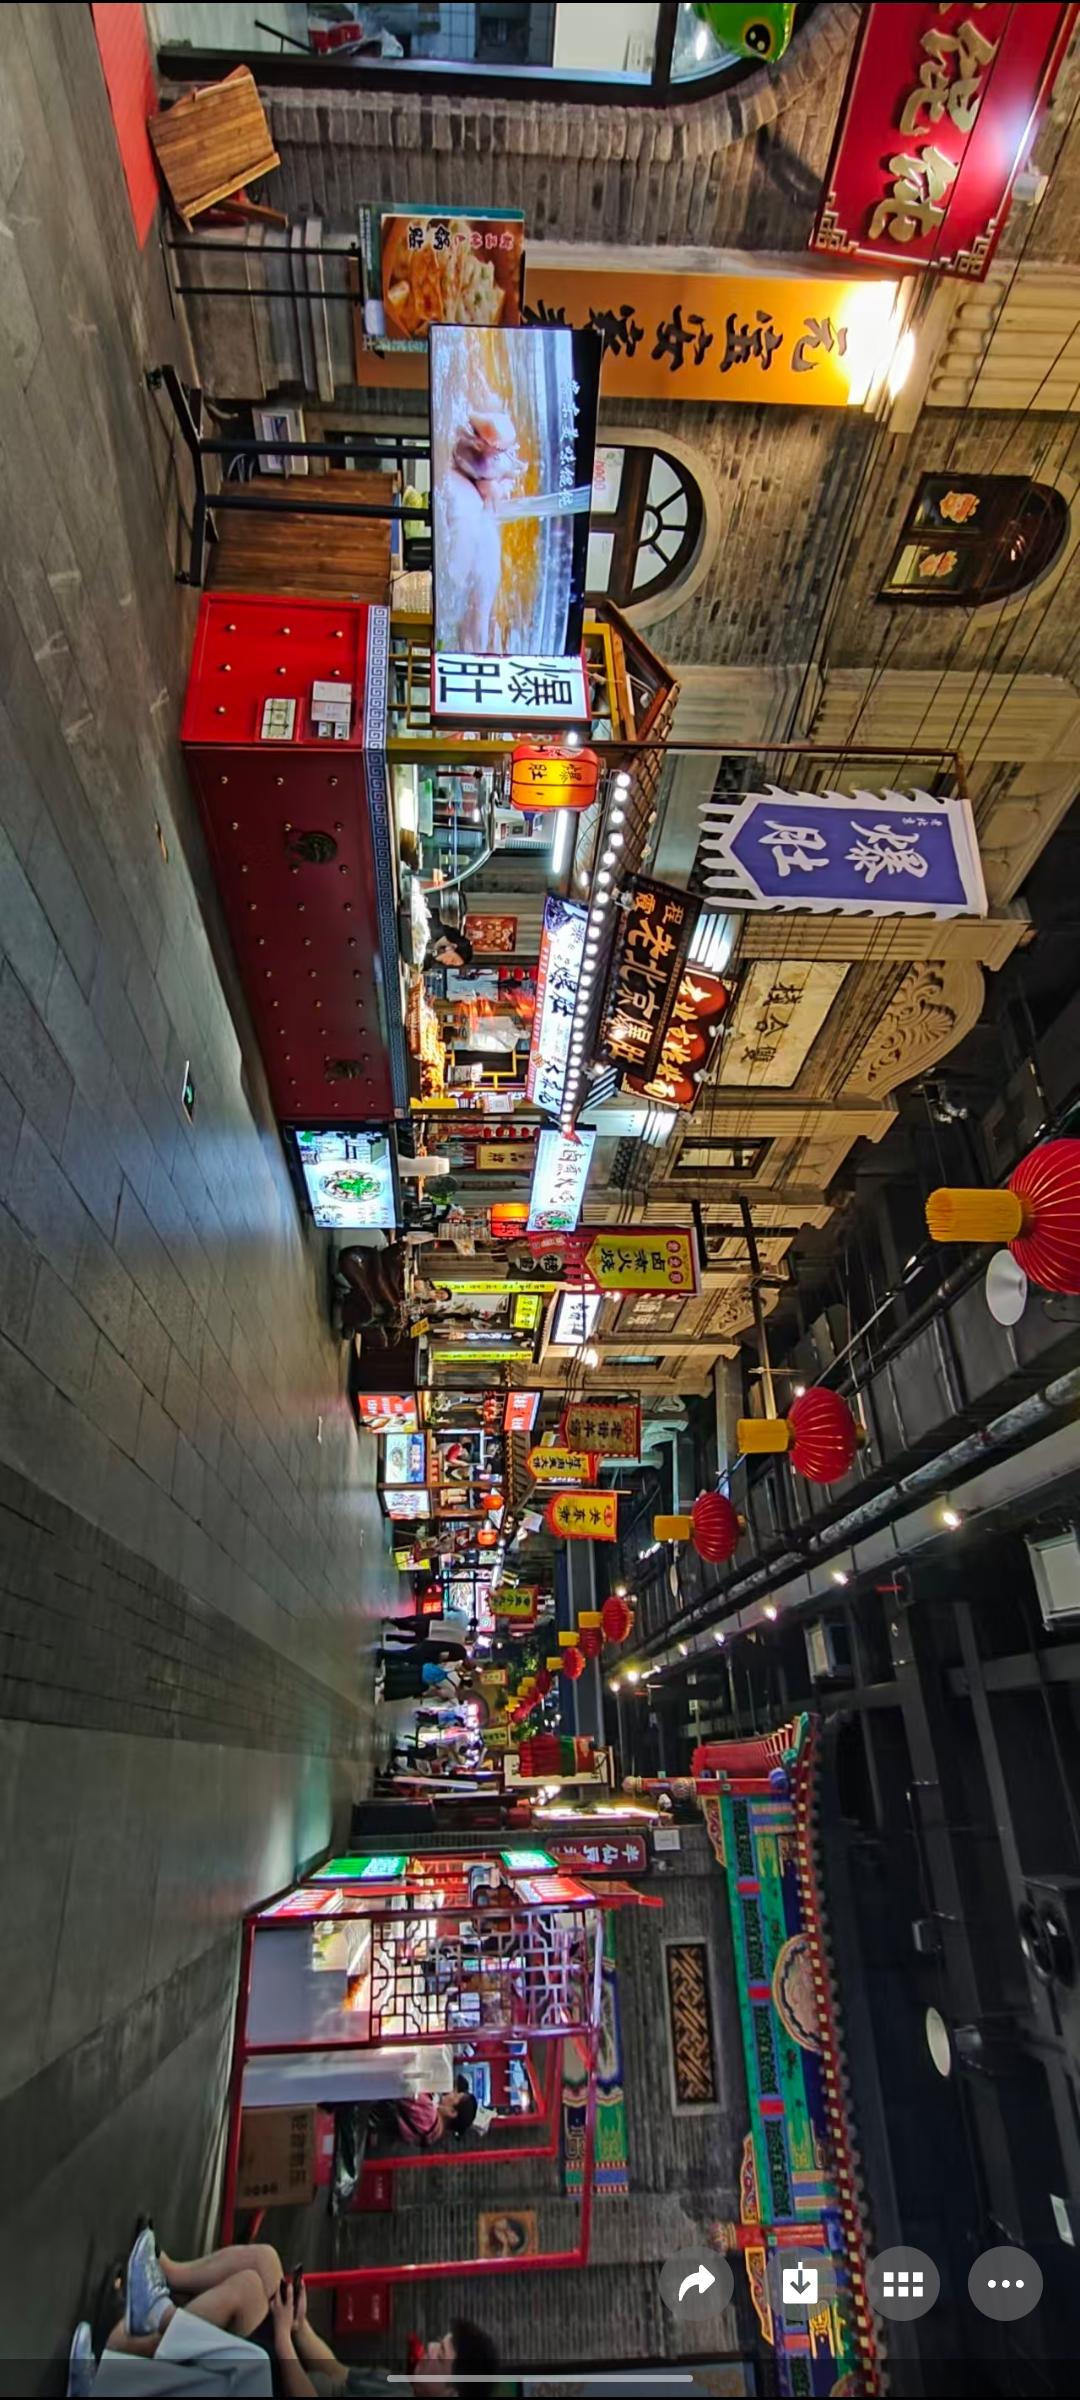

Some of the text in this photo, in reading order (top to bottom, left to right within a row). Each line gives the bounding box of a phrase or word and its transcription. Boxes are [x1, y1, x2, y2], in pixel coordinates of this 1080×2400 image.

[868, 4, 1000, 244] 馄饨
[408, 225, 451, 251] 锅贴
[436, 661, 573, 707] 爆肚
[527, 763, 583, 784] 爆肚
[901, 815, 943, 828] 老北京
[757, 821, 929, 885] 爆肚
[548, 966, 579, 1018] 爆肚
[605, 917, 675, 1066] 老北京爆肚
[600, 1247, 666, 1274] 卤煮火烧
[558, 1505, 601, 1525] 关东煮
